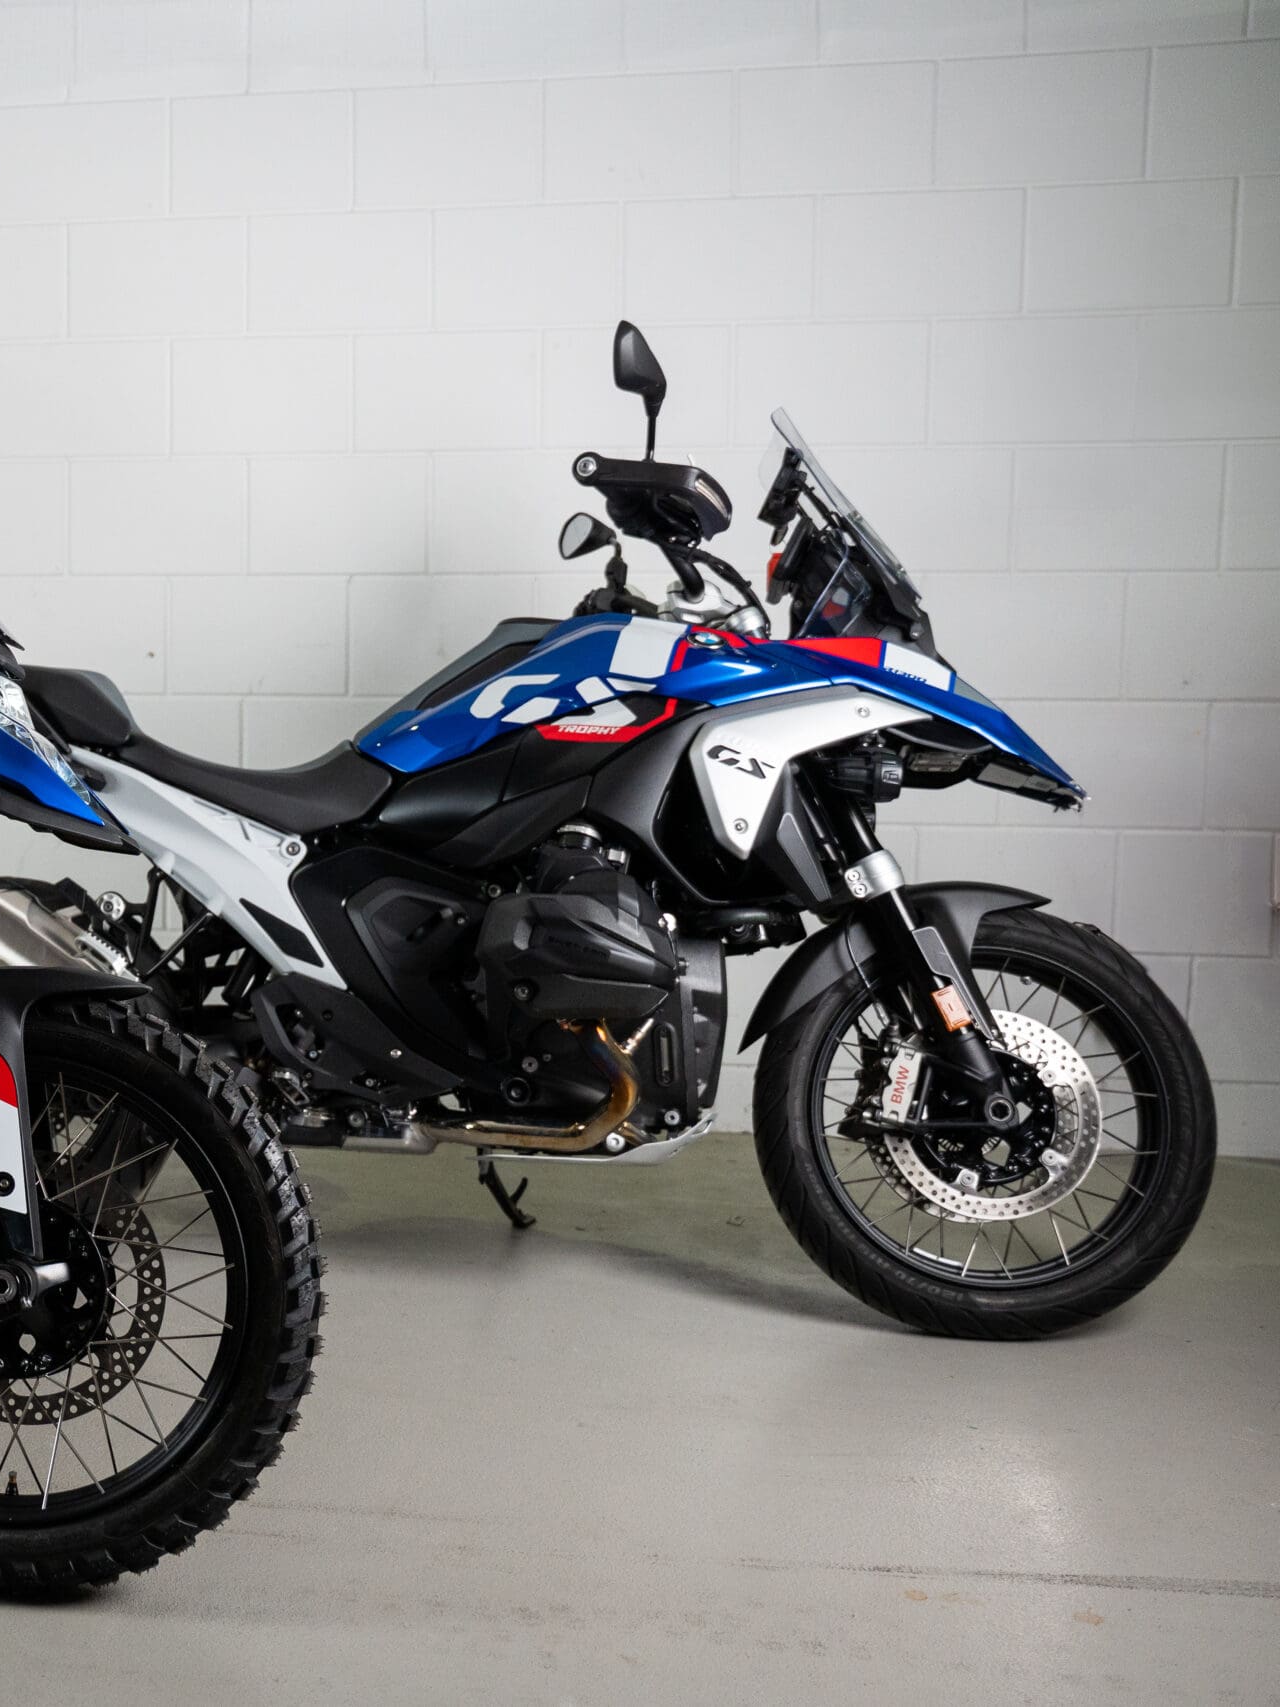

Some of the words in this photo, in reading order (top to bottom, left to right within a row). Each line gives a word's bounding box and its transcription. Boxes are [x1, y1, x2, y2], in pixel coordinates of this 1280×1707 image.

[470, 673, 657, 728] GS
[557, 724, 621, 737] TROPHY
[707, 745, 776, 779] GS
[890, 1065, 910, 1104] BMW
